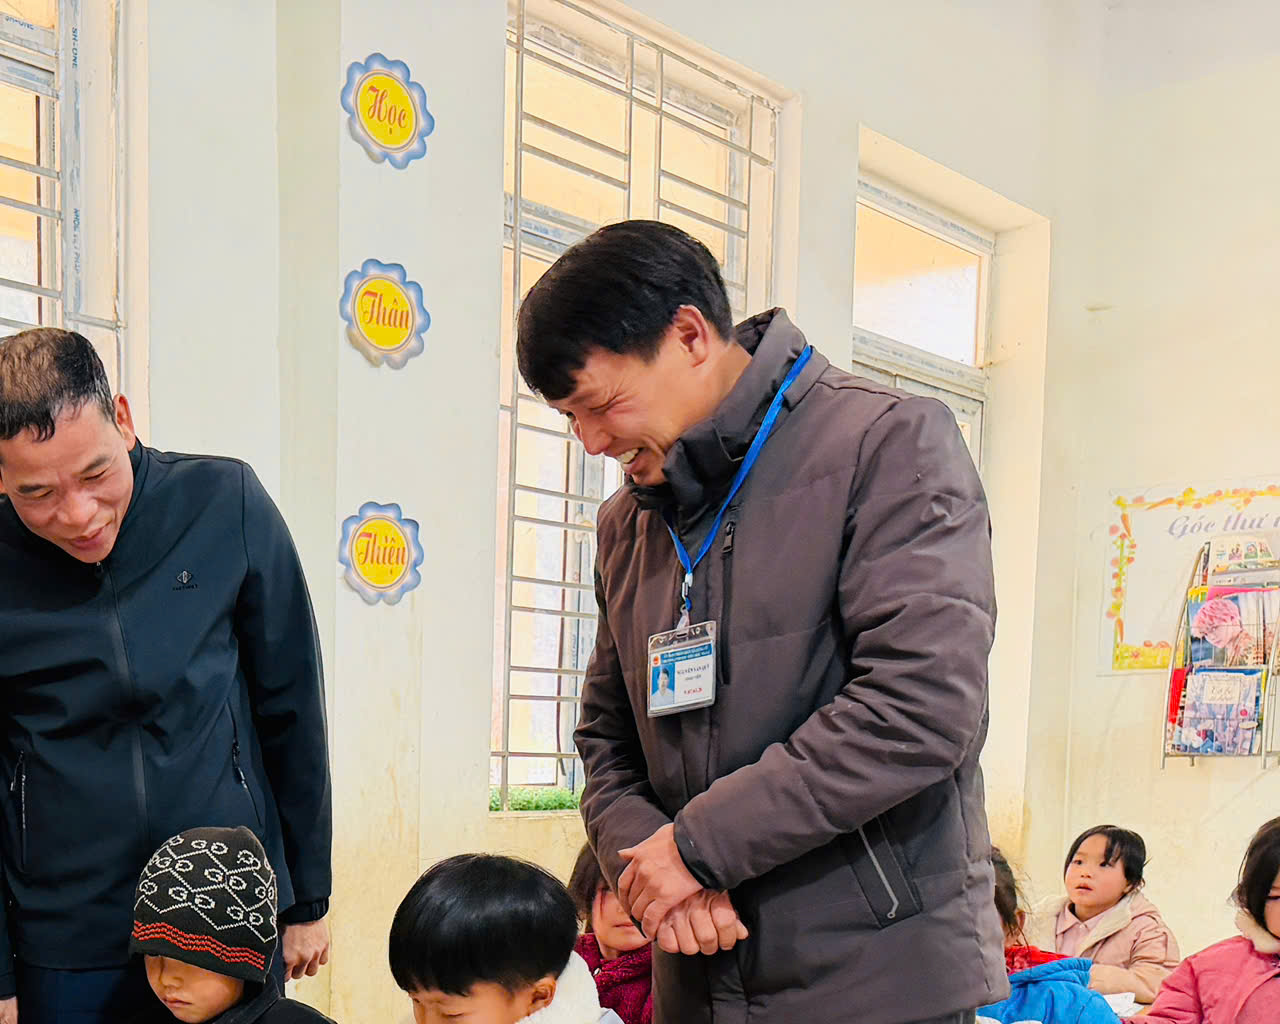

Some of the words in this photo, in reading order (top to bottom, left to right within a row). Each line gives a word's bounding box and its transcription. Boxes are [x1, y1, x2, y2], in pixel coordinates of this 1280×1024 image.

[367, 84, 408, 135] Học
[360, 289, 410, 330] Thân
[1168, 515, 1216, 540] Góc
[1223, 512, 1269, 532] thư
[358, 531, 406, 575] Thiện
